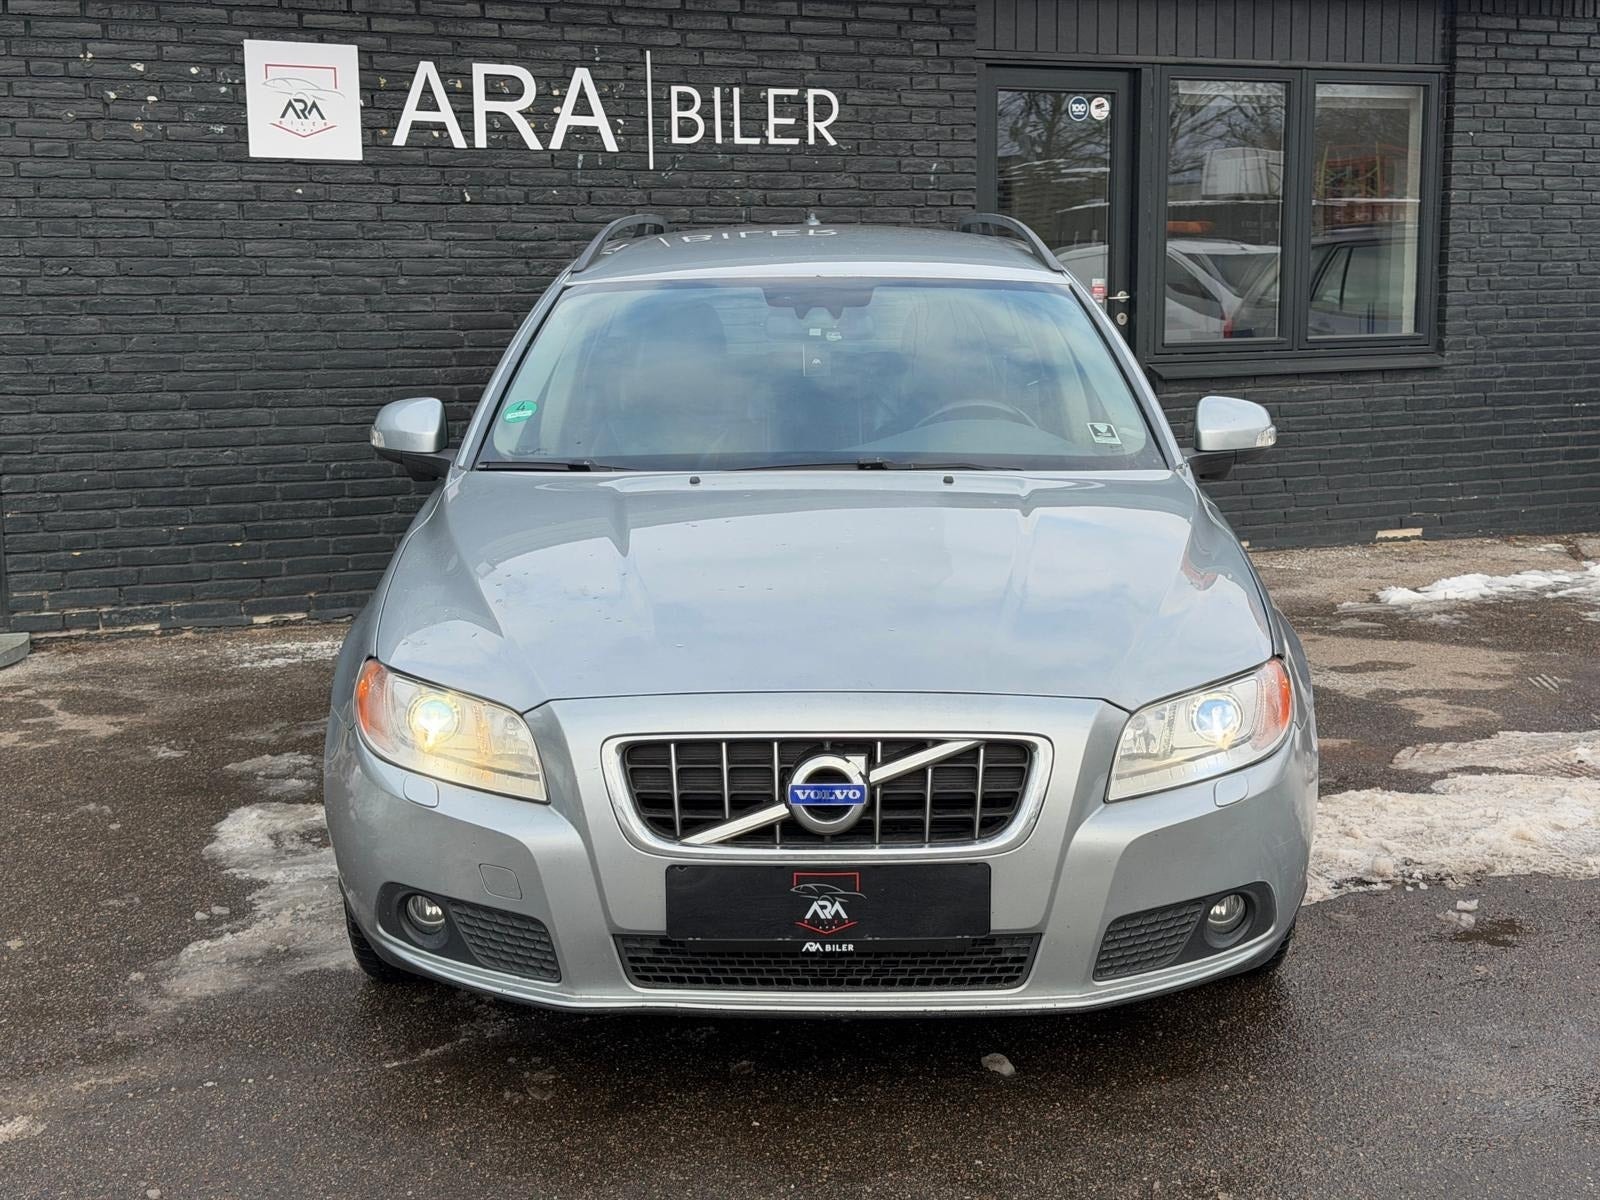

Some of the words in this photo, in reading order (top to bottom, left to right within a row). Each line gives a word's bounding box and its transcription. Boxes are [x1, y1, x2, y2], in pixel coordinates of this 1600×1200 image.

[280, 98, 326, 120] ARA
[392, 61, 619, 152] ARA
[670, 85, 838, 146] BILER
[794, 789, 861, 800] VOLVO
[804, 900, 849, 919] ARA
[801, 942, 824, 952] ARA
[825, 944, 854, 952] BILER
